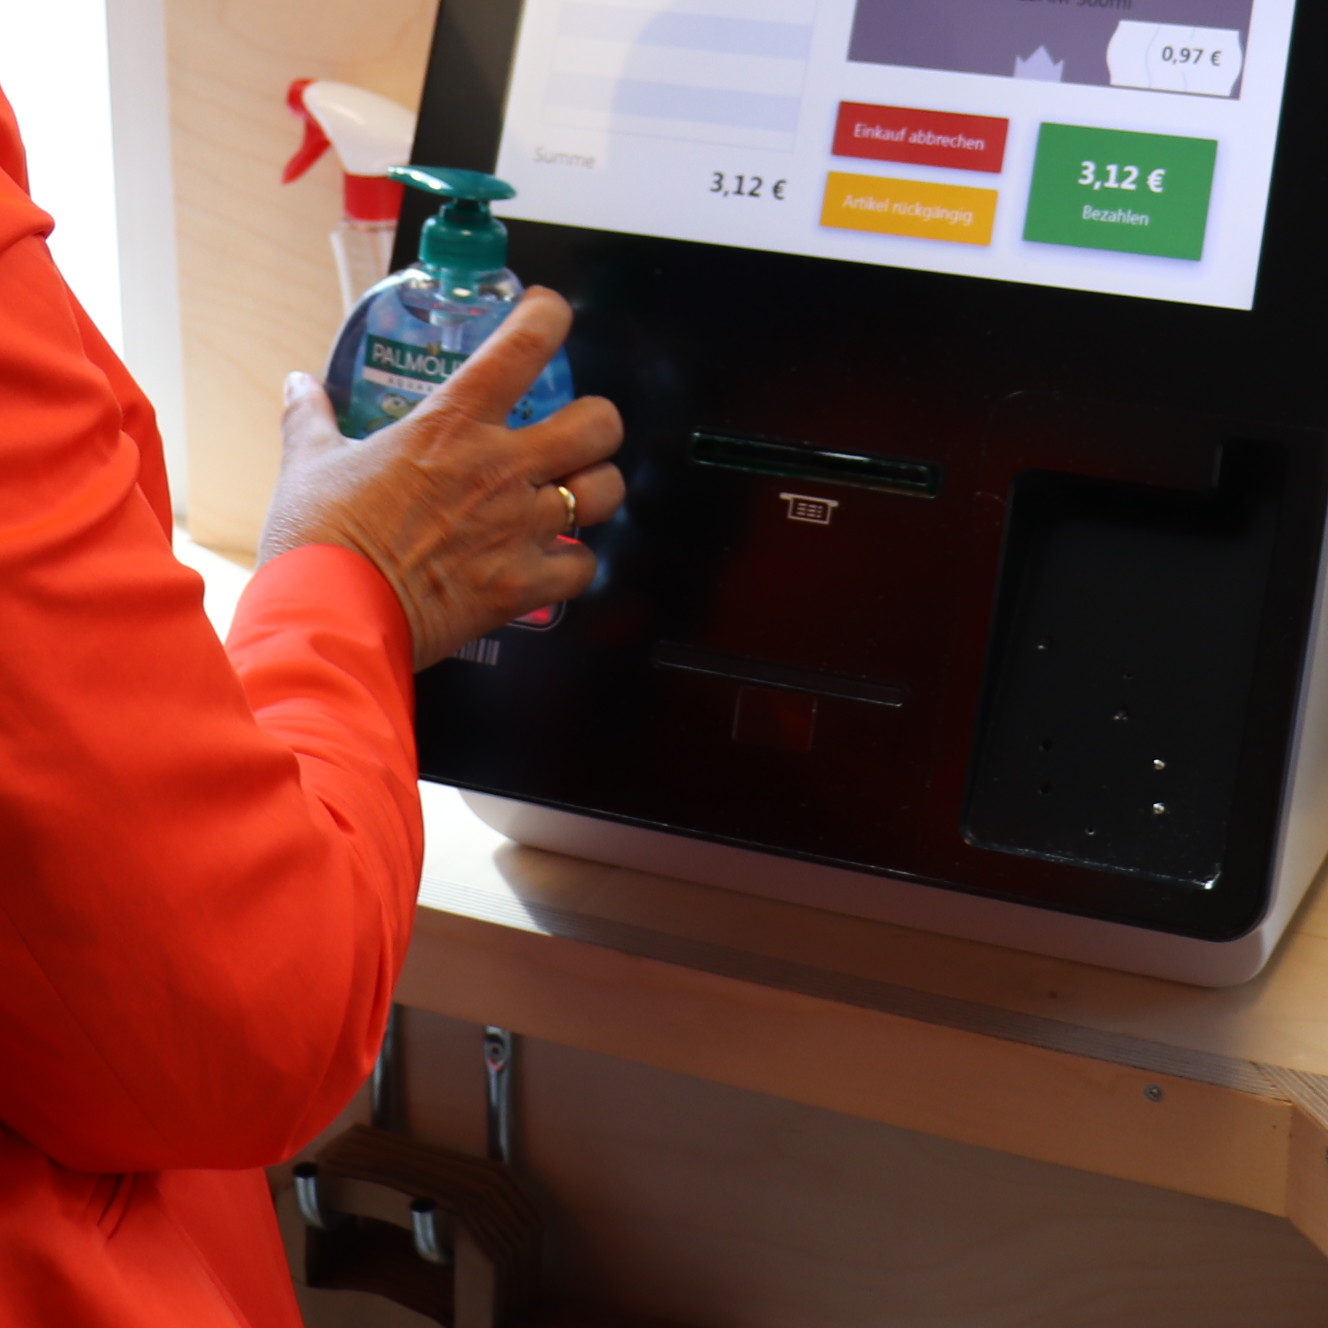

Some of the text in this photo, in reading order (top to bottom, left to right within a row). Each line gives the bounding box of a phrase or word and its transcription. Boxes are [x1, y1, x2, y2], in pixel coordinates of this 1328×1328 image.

[1161, 46, 1223, 66] 0,97 €
[853, 123, 986, 151] Einkauf abbrechen
[533, 146, 596, 169] Summe
[709, 171, 787, 200] 3,12 €
[1078, 161, 1167, 193] 3,12 €
[842, 194, 974, 227] Artikel rückgängig
[1082, 205, 1150, 226] Bezahlen
[372, 341, 463, 378] PALMOLI
